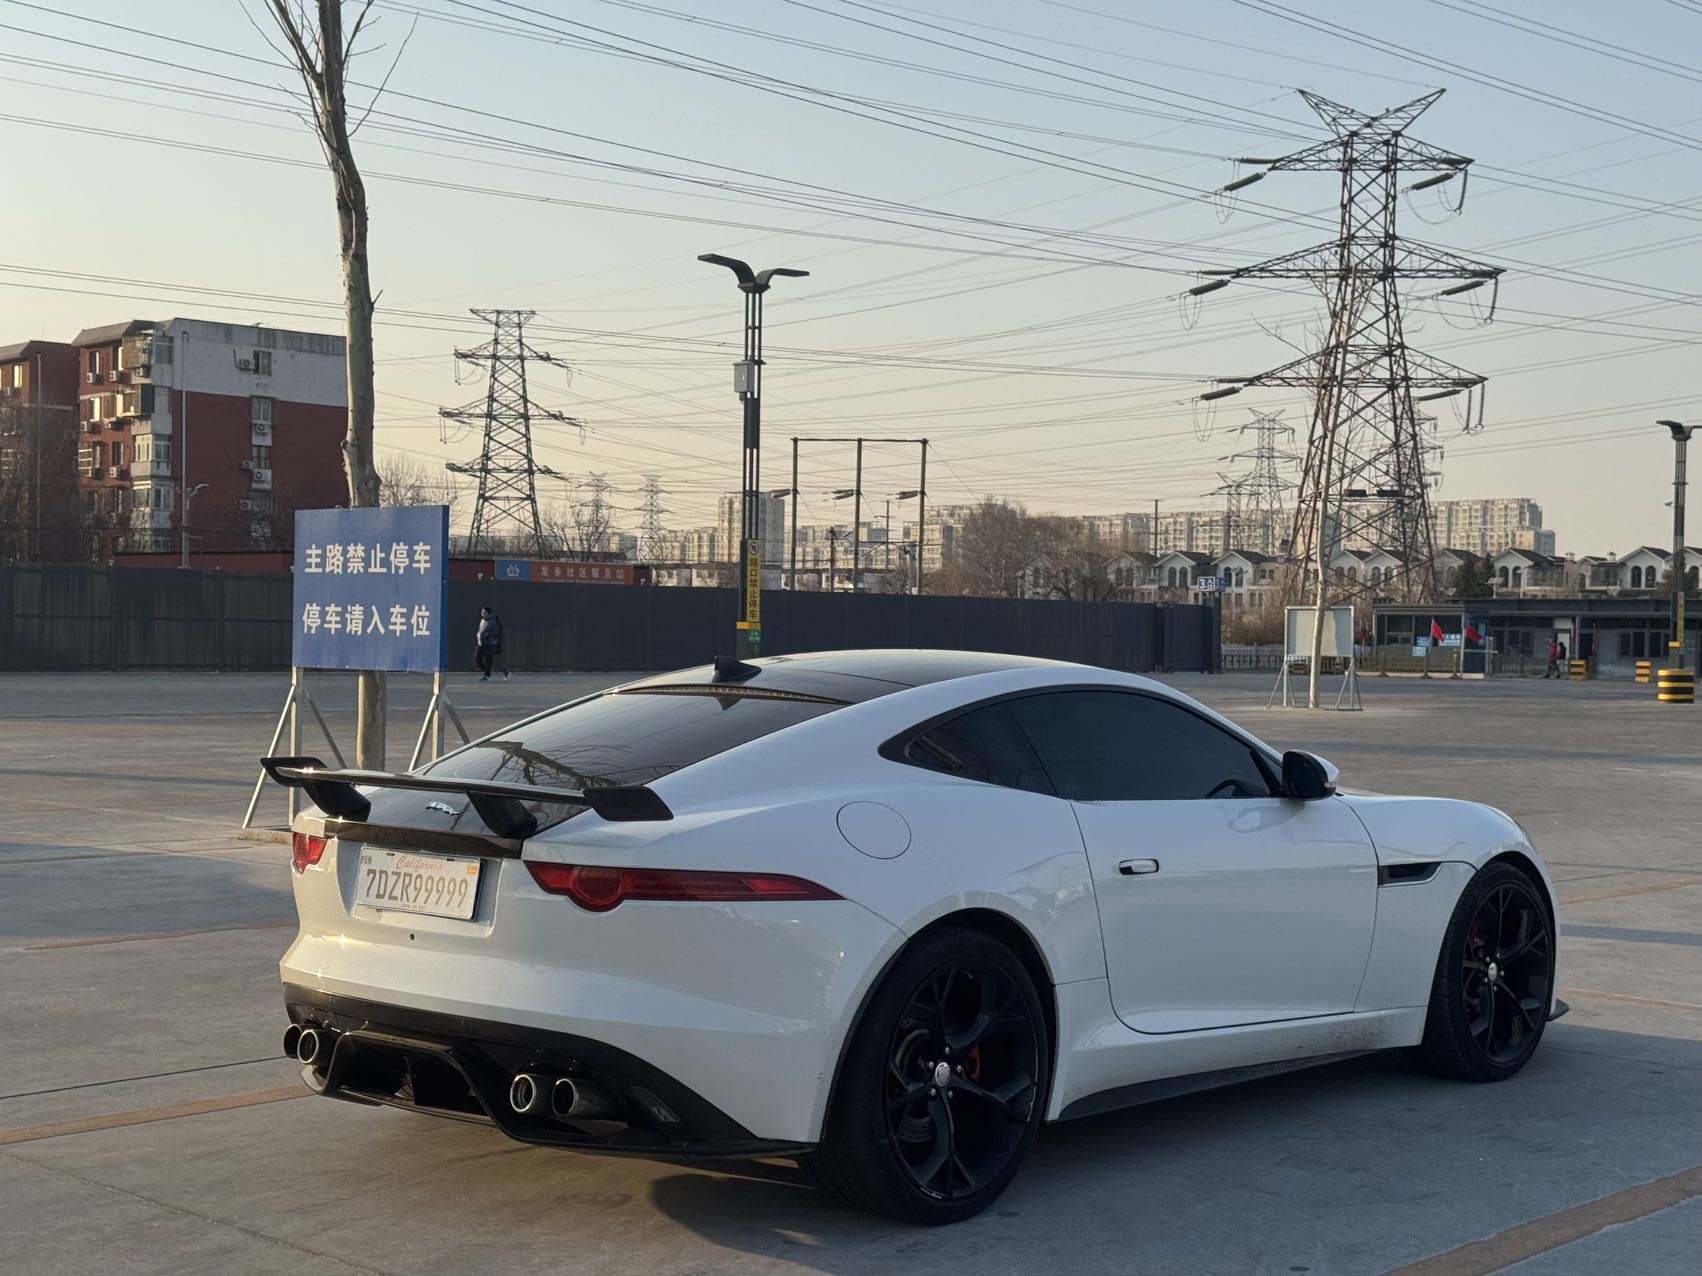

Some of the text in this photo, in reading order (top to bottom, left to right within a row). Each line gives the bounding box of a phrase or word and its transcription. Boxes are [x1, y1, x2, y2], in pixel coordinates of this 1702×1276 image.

[304, 542, 431, 574] 主路禁止停车
[302, 603, 430, 637] 停车请入车位
[396, 855, 443, 873] California
[366, 868, 468, 908] 7DZR99999
